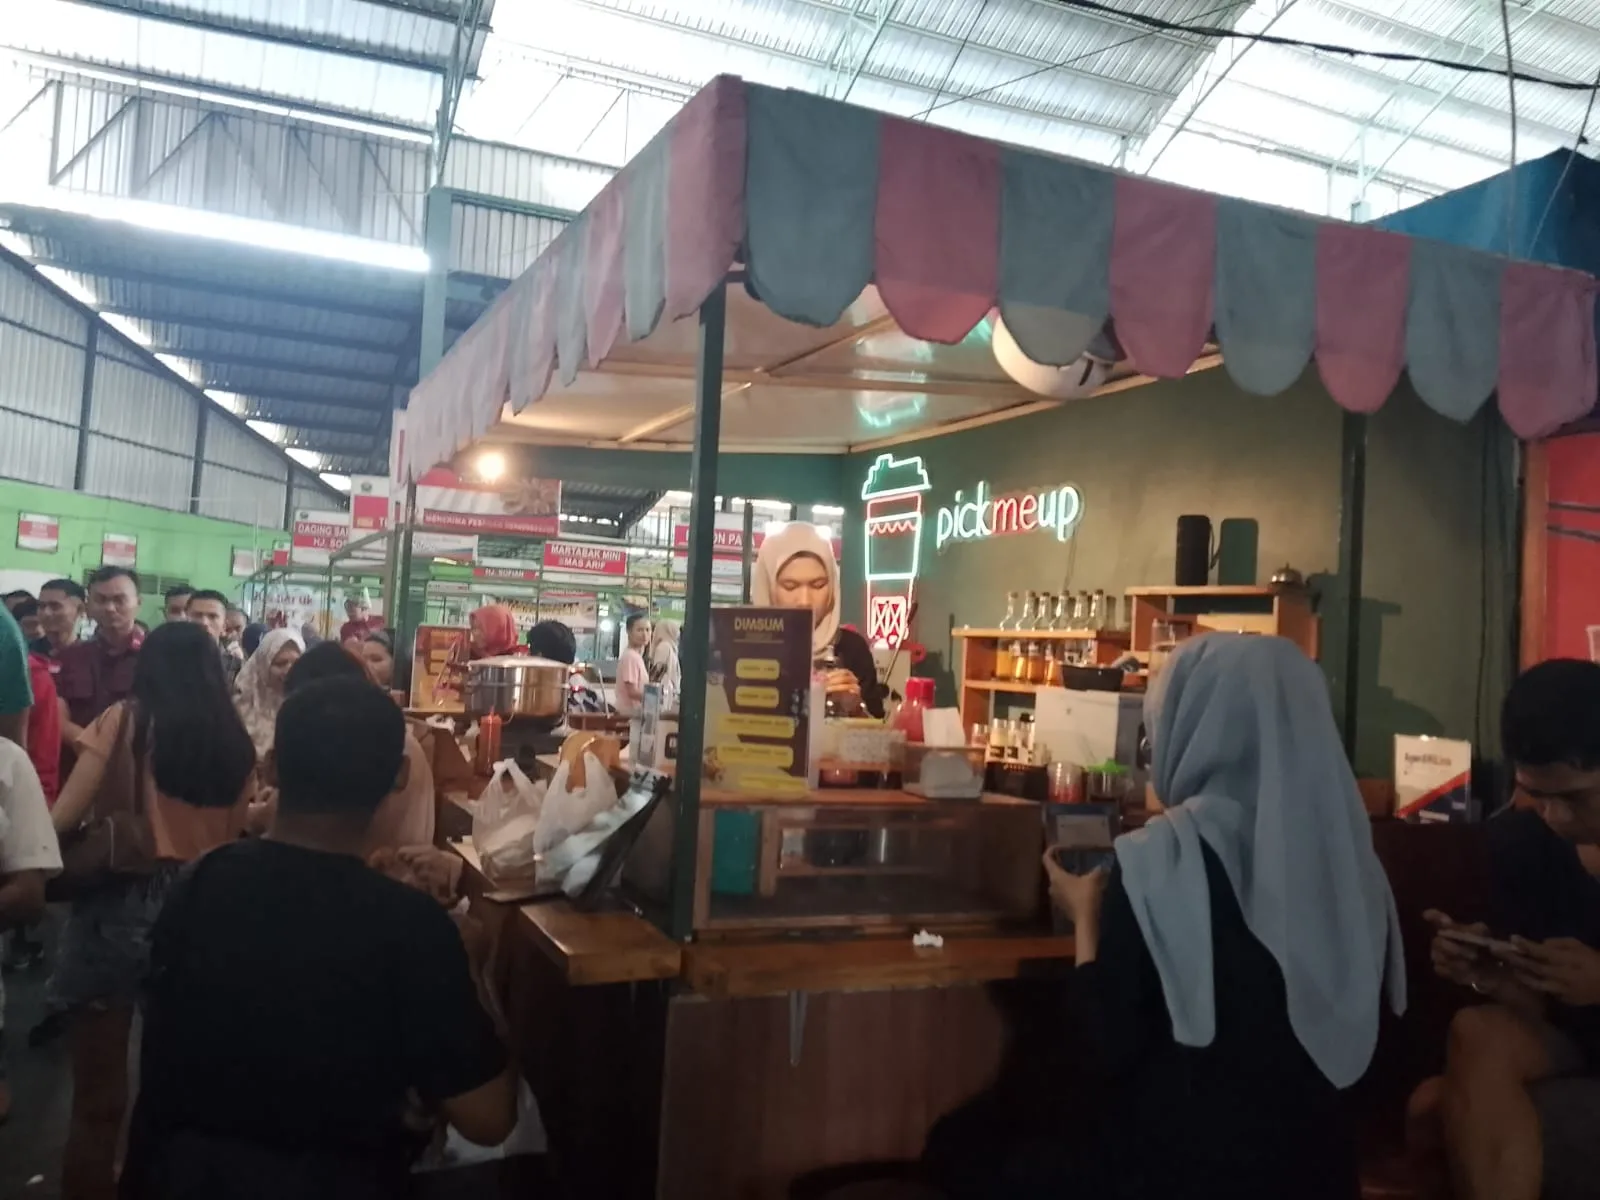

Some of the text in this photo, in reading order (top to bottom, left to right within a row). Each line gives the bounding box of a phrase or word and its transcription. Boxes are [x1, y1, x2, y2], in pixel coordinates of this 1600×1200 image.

[936, 480, 1080, 550] pickmeup
[298, 523, 332, 537] DAGING
[551, 543, 621, 562] MARTABAK MINI
[585, 560, 606, 570] ARIF
[734, 616, 784, 632] DIMSUM
